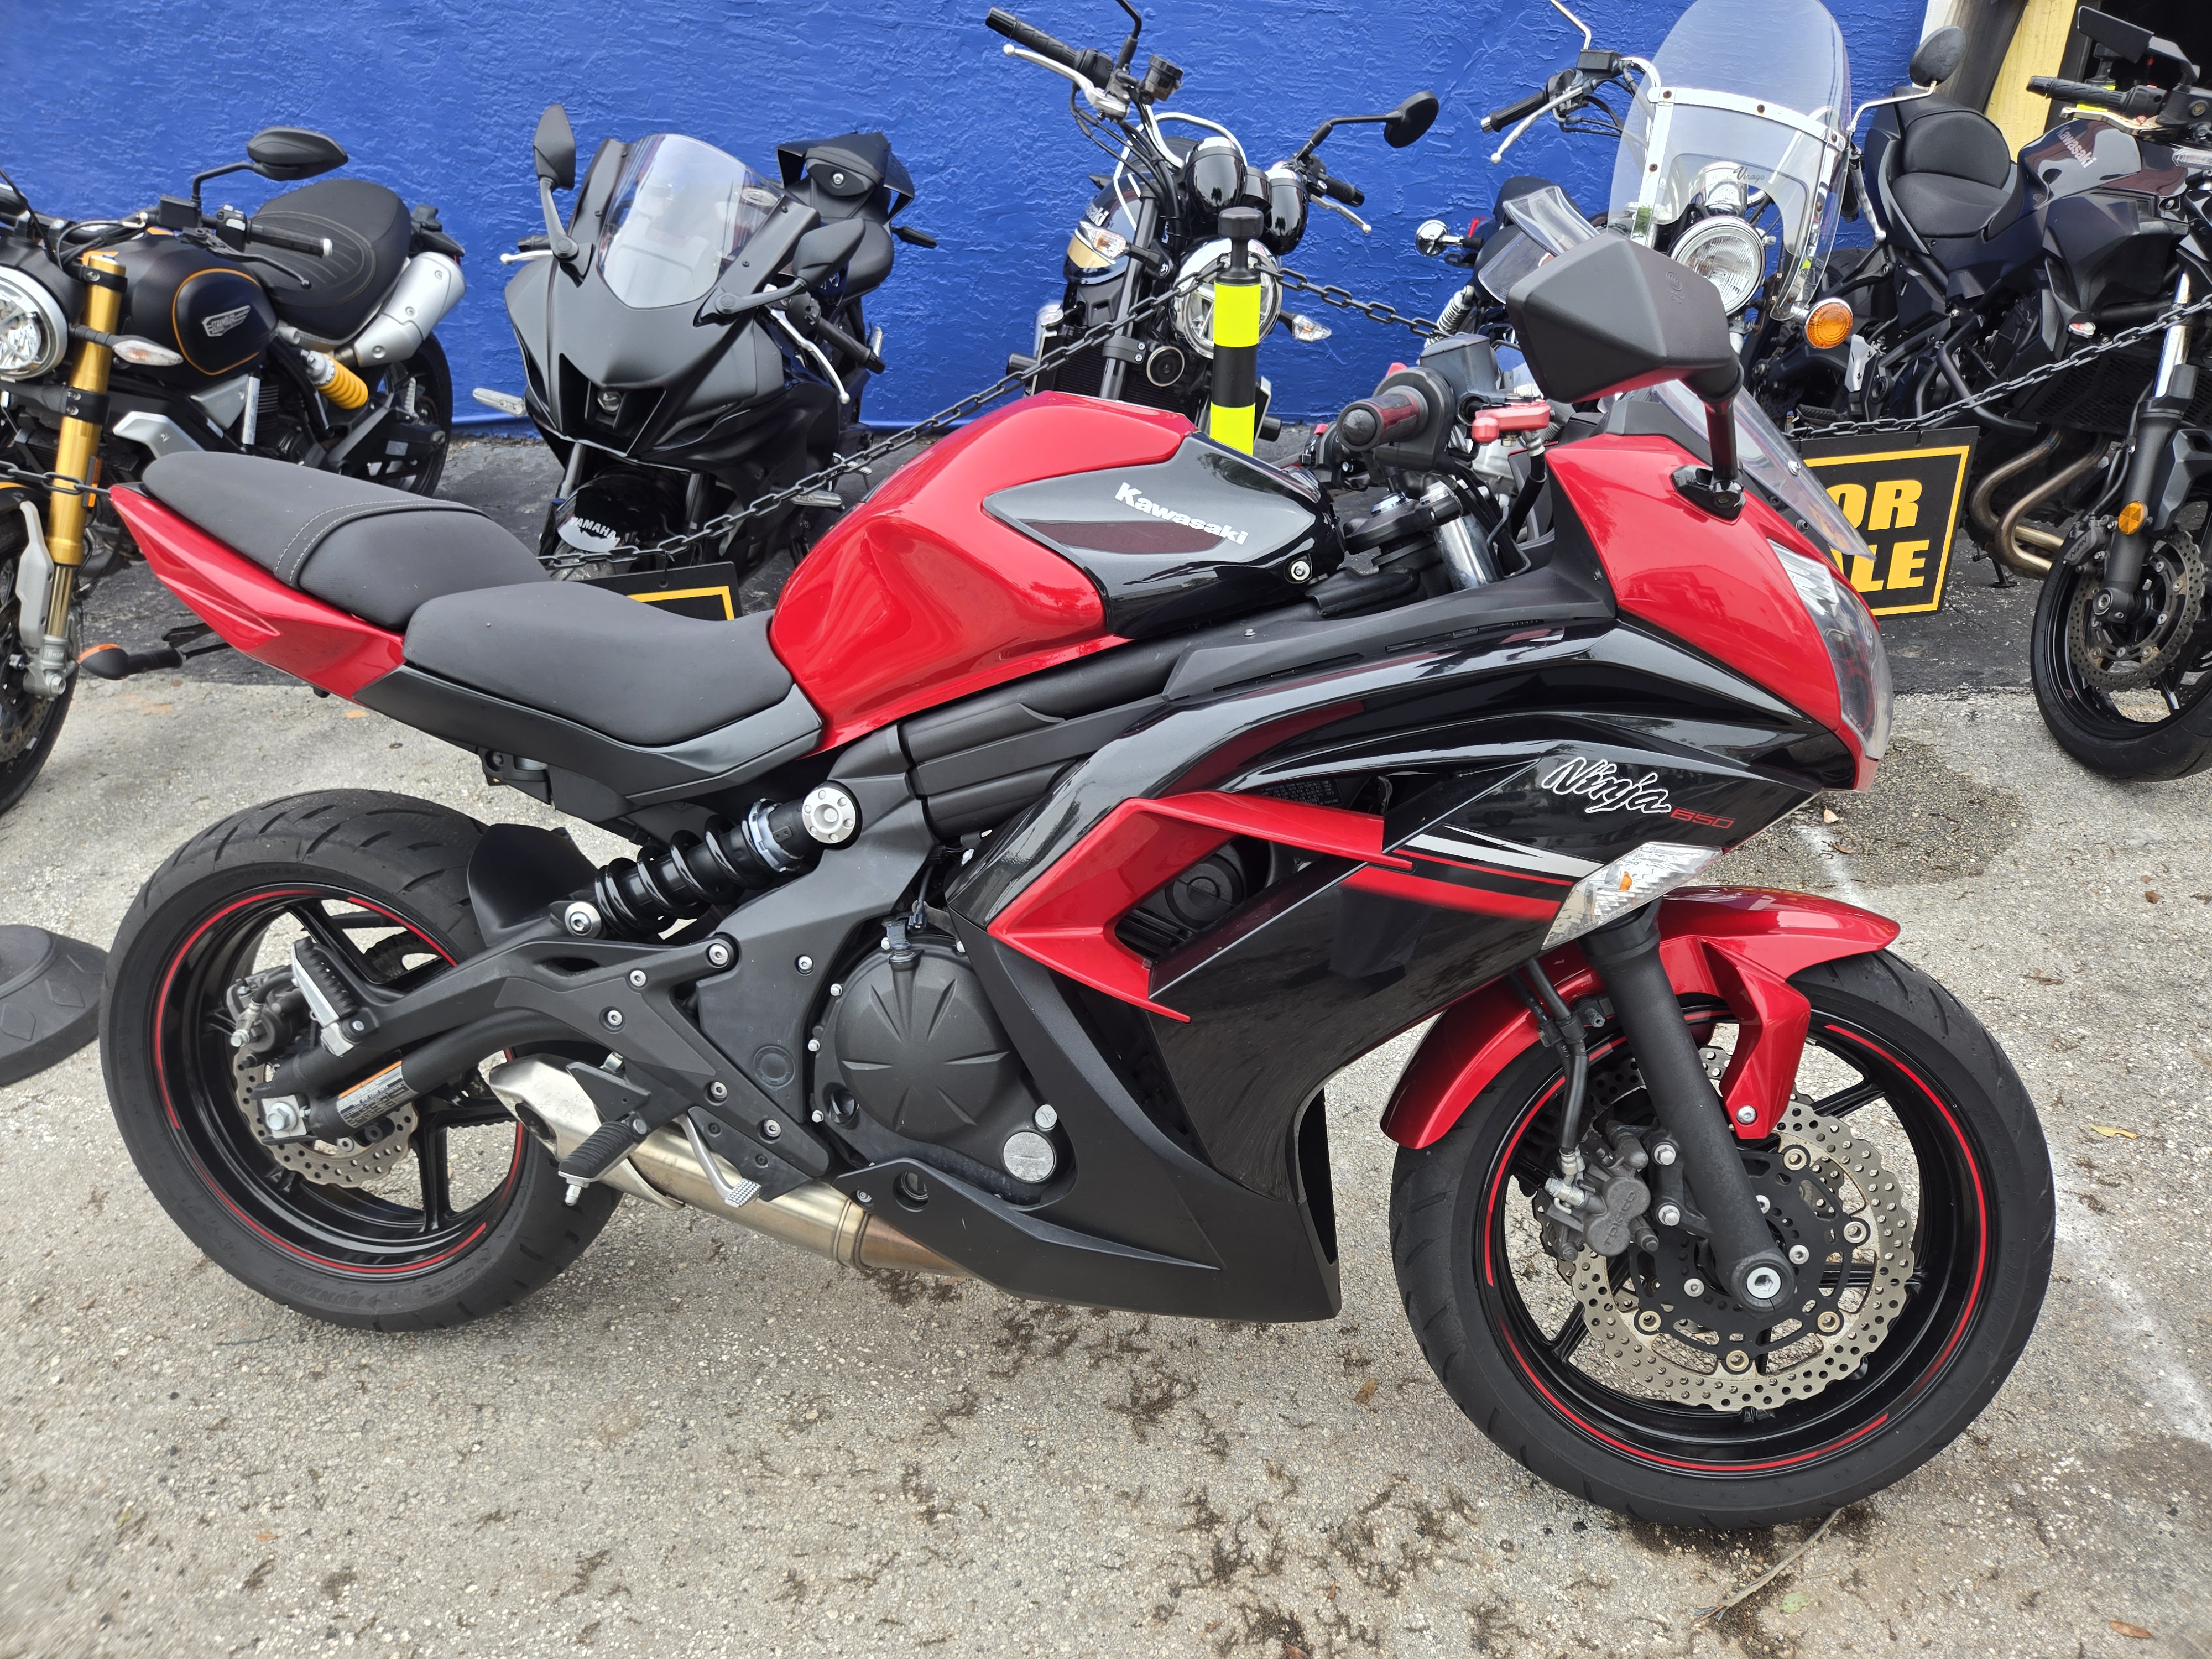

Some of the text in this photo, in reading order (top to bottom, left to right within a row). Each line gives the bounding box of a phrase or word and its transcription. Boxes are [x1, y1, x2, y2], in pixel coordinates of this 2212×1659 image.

[2056, 125, 2097, 168] Kawasaki
[1733, 166, 1765, 184] Virago
[1085, 200, 1109, 227] saki
[1115, 482, 1249, 546] Kawasaki
[1826, 479, 1922, 531] OR
[570, 516, 617, 541] YAMAHA
[1541, 757, 1734, 829] Ninja 650
[279, 1276, 364, 1307] DUNLOP
[1982, 1261, 2018, 1355] DUNLOP
